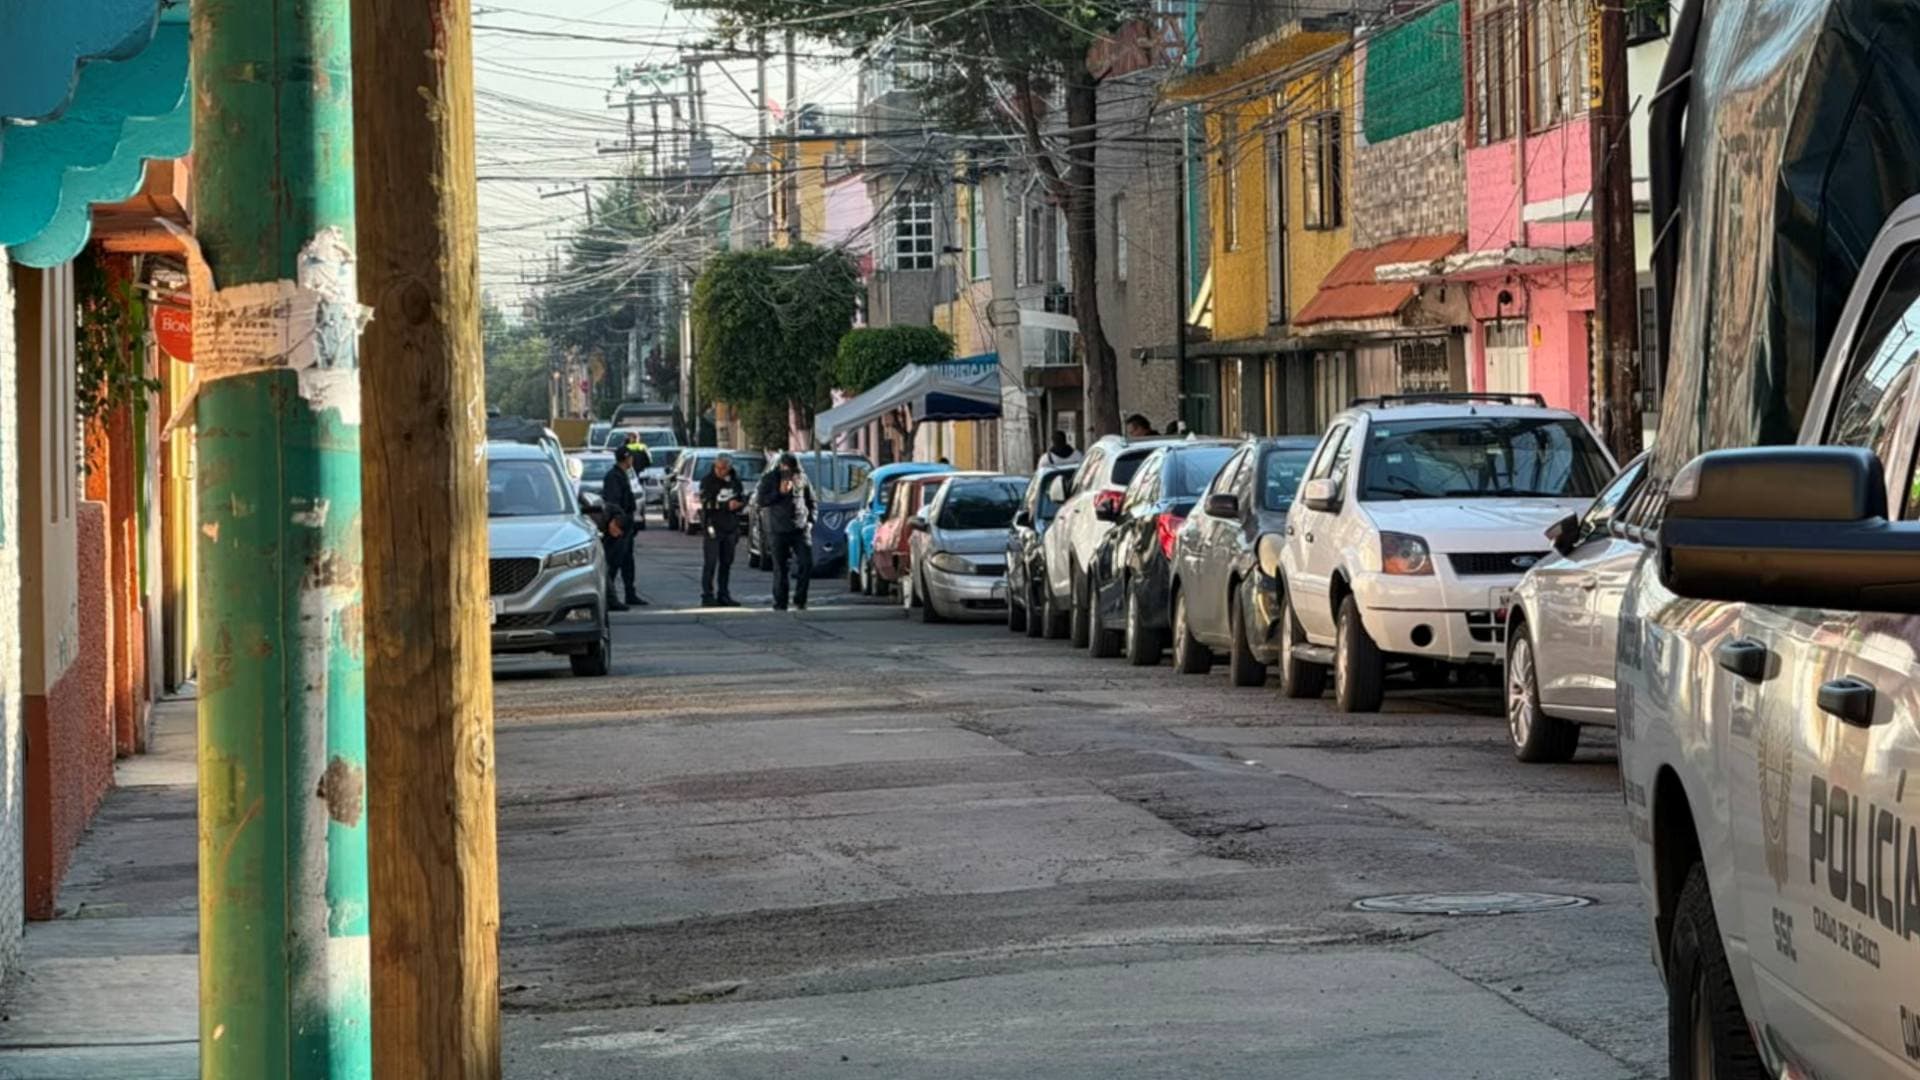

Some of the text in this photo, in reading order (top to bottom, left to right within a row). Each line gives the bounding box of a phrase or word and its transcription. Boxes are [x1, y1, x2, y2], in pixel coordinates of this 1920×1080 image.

[1809, 769, 1920, 941] POLICÍA
[1813, 906, 1881, 969] CIUDAD DE MÉXICO
